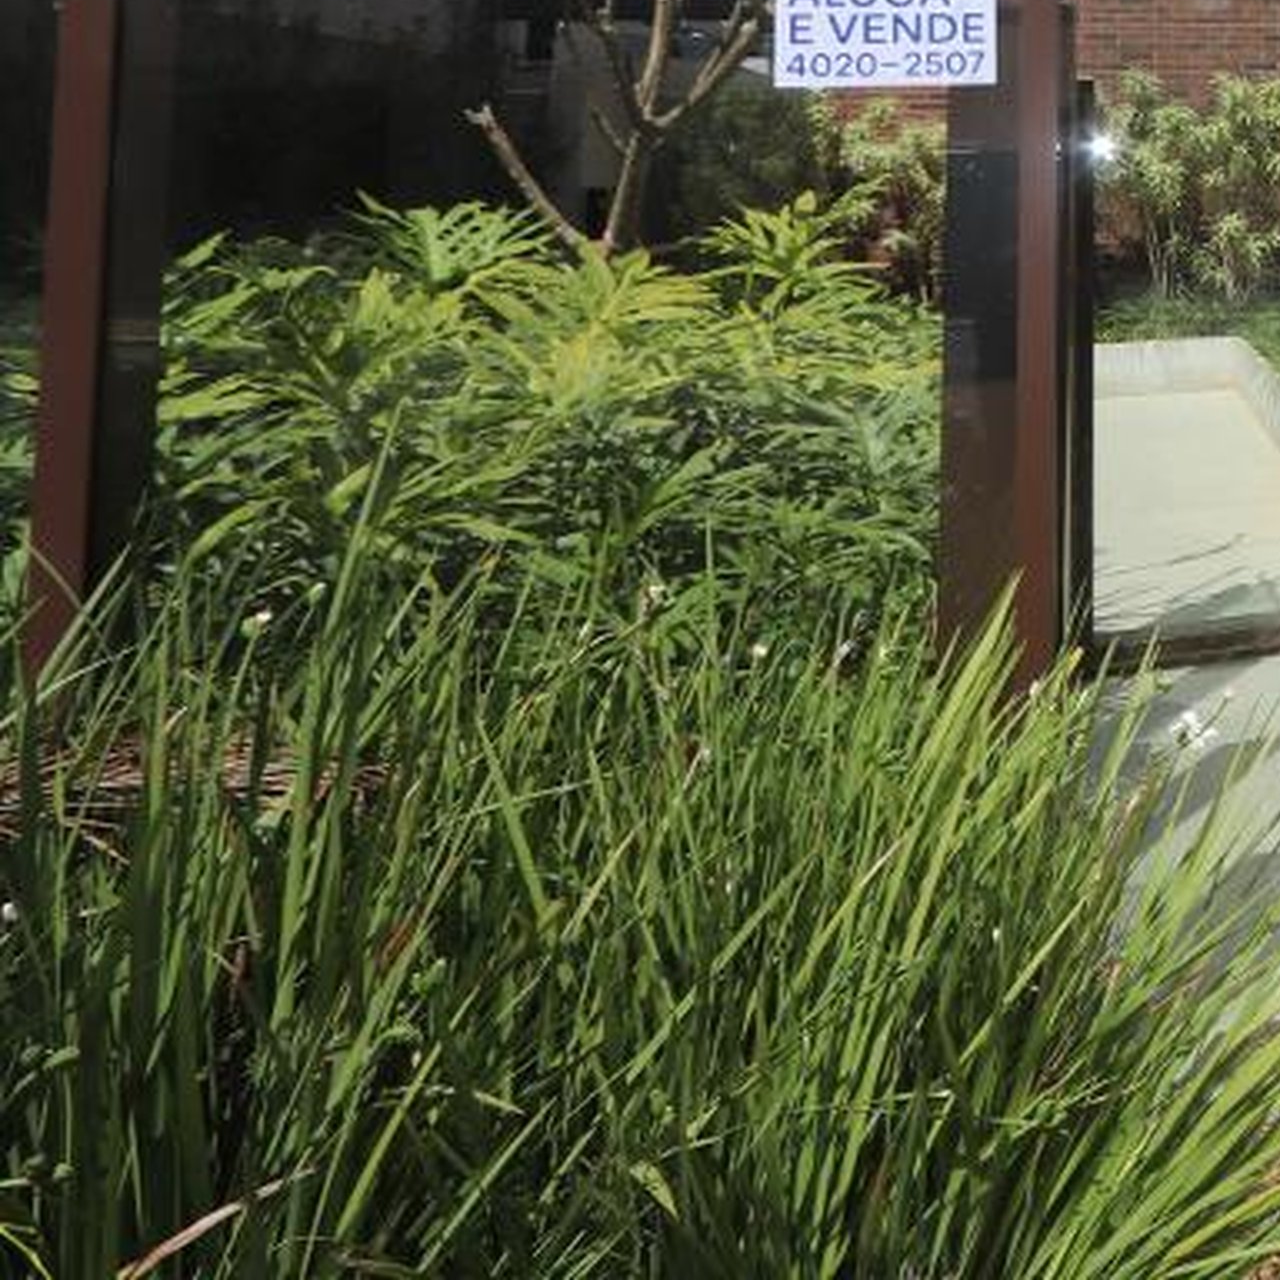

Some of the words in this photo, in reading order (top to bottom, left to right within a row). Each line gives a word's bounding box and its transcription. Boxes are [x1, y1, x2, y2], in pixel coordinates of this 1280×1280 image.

[789, 13, 814, 44] E
[828, 12, 985, 44] VENDE
[786, 51, 985, 77] 4020-2507
